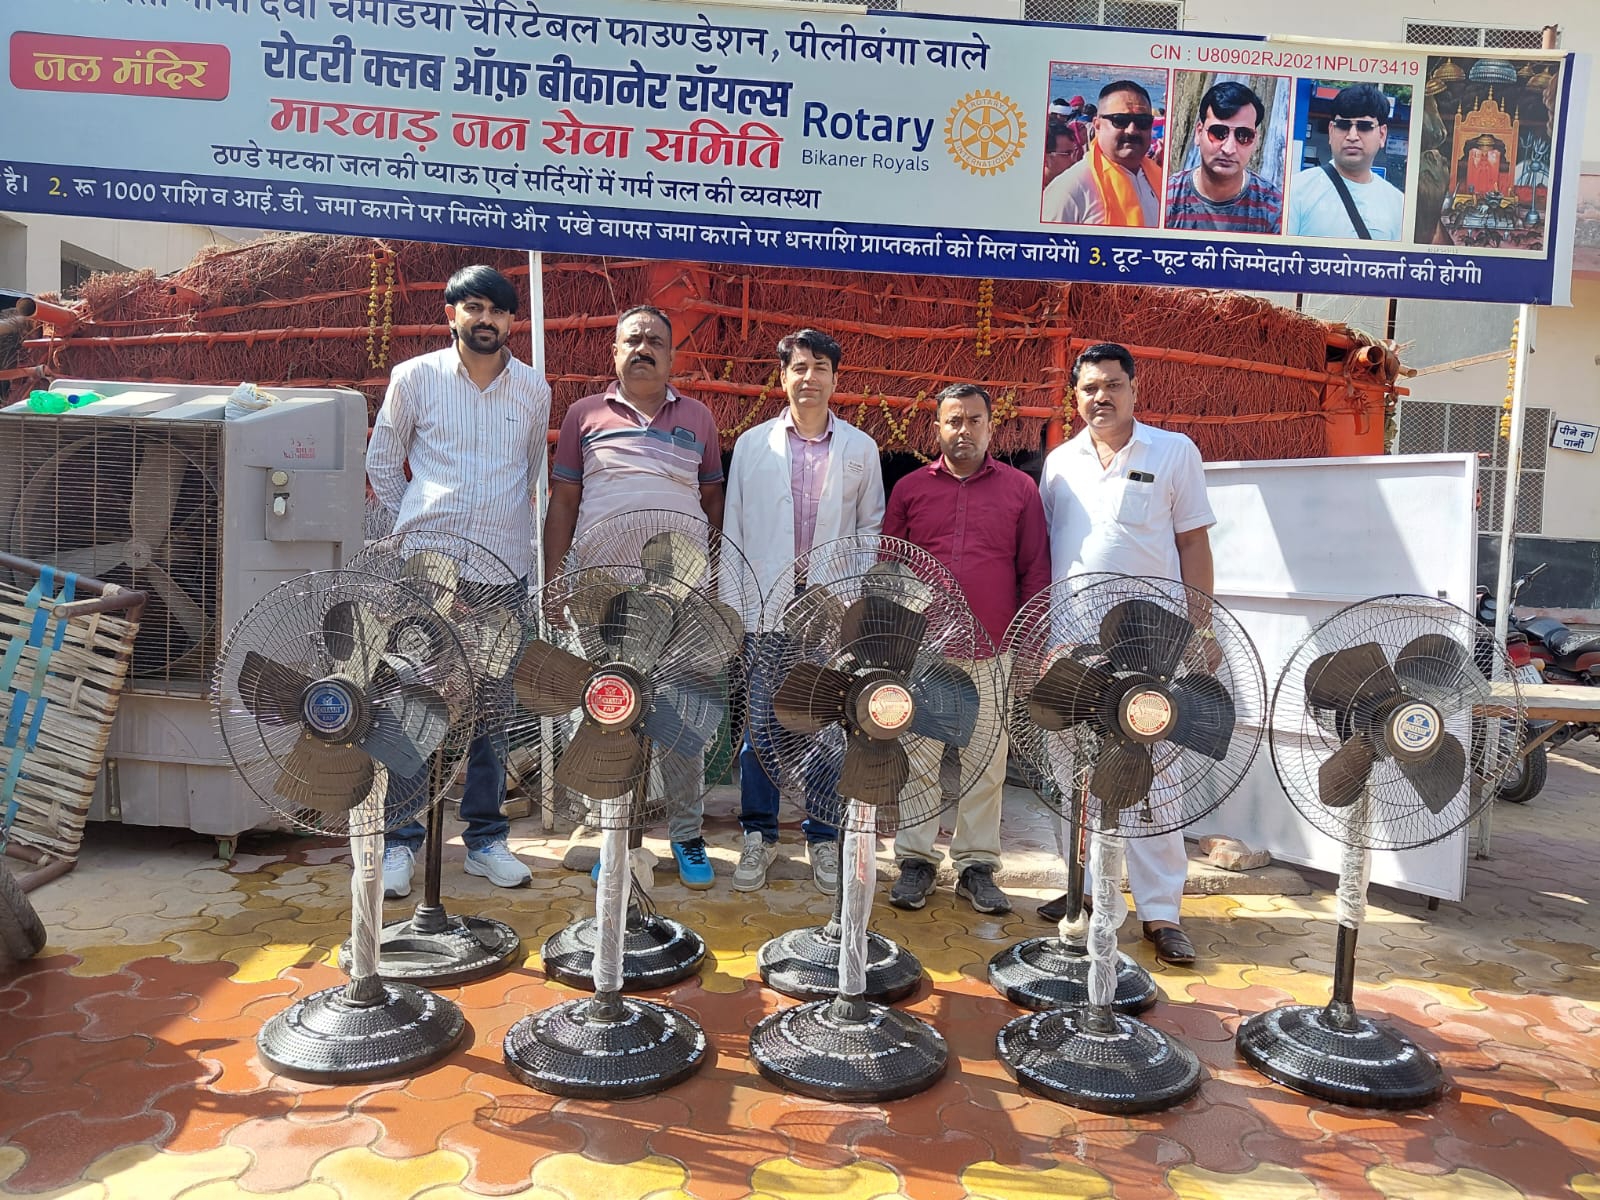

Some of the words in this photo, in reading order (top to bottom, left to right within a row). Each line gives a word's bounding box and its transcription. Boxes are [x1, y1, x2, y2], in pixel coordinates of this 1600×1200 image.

[460, 0, 600, 44] चैरिटेबल
[605, 14, 779, 62] फाउण्डेशन,
[785, 21, 920, 65] पीलीबंगा
[924, 32, 991, 71] वाले
[33, 52, 103, 82] जल
[112, 48, 208, 90] मंदिर
[261, 30, 356, 84] रोटरी
[361, 49, 445, 91] क्लब
[536, 54, 671, 109] बीकानेर
[676, 64, 793, 117] रॉयल्स
[1150, 44, 1181, 60] CIN
[1198, 48, 1419, 76] U80902RJ2021NPL073419
[970, 98, 1003, 110] ROTARY
[270, 98, 440, 152] मारवाड़
[452, 113, 530, 151] जन
[542, 109, 634, 158] सेवा
[646, 119, 784, 168] समिति
[803, 102, 934, 152] Rotary
[211, 139, 262, 168] ठण्डे
[266, 149, 335, 174] मटका
[338, 153, 382, 177] जल
[385, 152, 420, 181] की
[422, 161, 480, 185] प्याऊ
[482, 162, 519, 194] एवं
[523, 165, 593, 196] सर्दियों
[596, 168, 616, 196] में
[619, 172, 654, 199] गर्म
[658, 179, 700, 202] जल
[703, 176, 735, 204] की
[738, 185, 822, 210] व्यवस्था
[802, 150, 867, 168] Bikaner
[873, 154, 929, 174] Royals
[956, 145, 1014, 168] INTERNATIONAL
[4, 166, 28, 196] है।
[48, 177, 68, 198] 2.
[102, 181, 156, 202] 1000
[160, 180, 208, 206] राशि
[210, 188, 228, 207] व
[313, 196, 356, 217] जमा
[360, 196, 416, 221] कराने
[418, 204, 446, 224] पर
[448, 200, 508, 230] मिलेंगे
[510, 206, 551, 233] और
[556, 210, 594, 236] पंखे
[598, 218, 653, 240] वापस
[655, 222, 697, 243] जमा
[699, 221, 753, 247] कराने
[755, 229, 781, 249] पर
[784, 226, 857, 253] धनराशि
[859, 232, 944, 257] प्राप्तकर्ता
[946, 234, 974, 259] को
[976, 235, 1018, 261] मिल
[1089, 246, 1107, 267] 3.
[1190, 246, 1218, 270] की
[1221, 247, 1305, 275] जिम्मेदारी
[1308, 253, 1407, 281] उपयोगकर्ता
[1408, 258, 1437, 282] की
[1559, 424, 1578, 437] पीने
[1580, 430, 1595, 439] का
[1563, 438, 1585, 449] पानी
